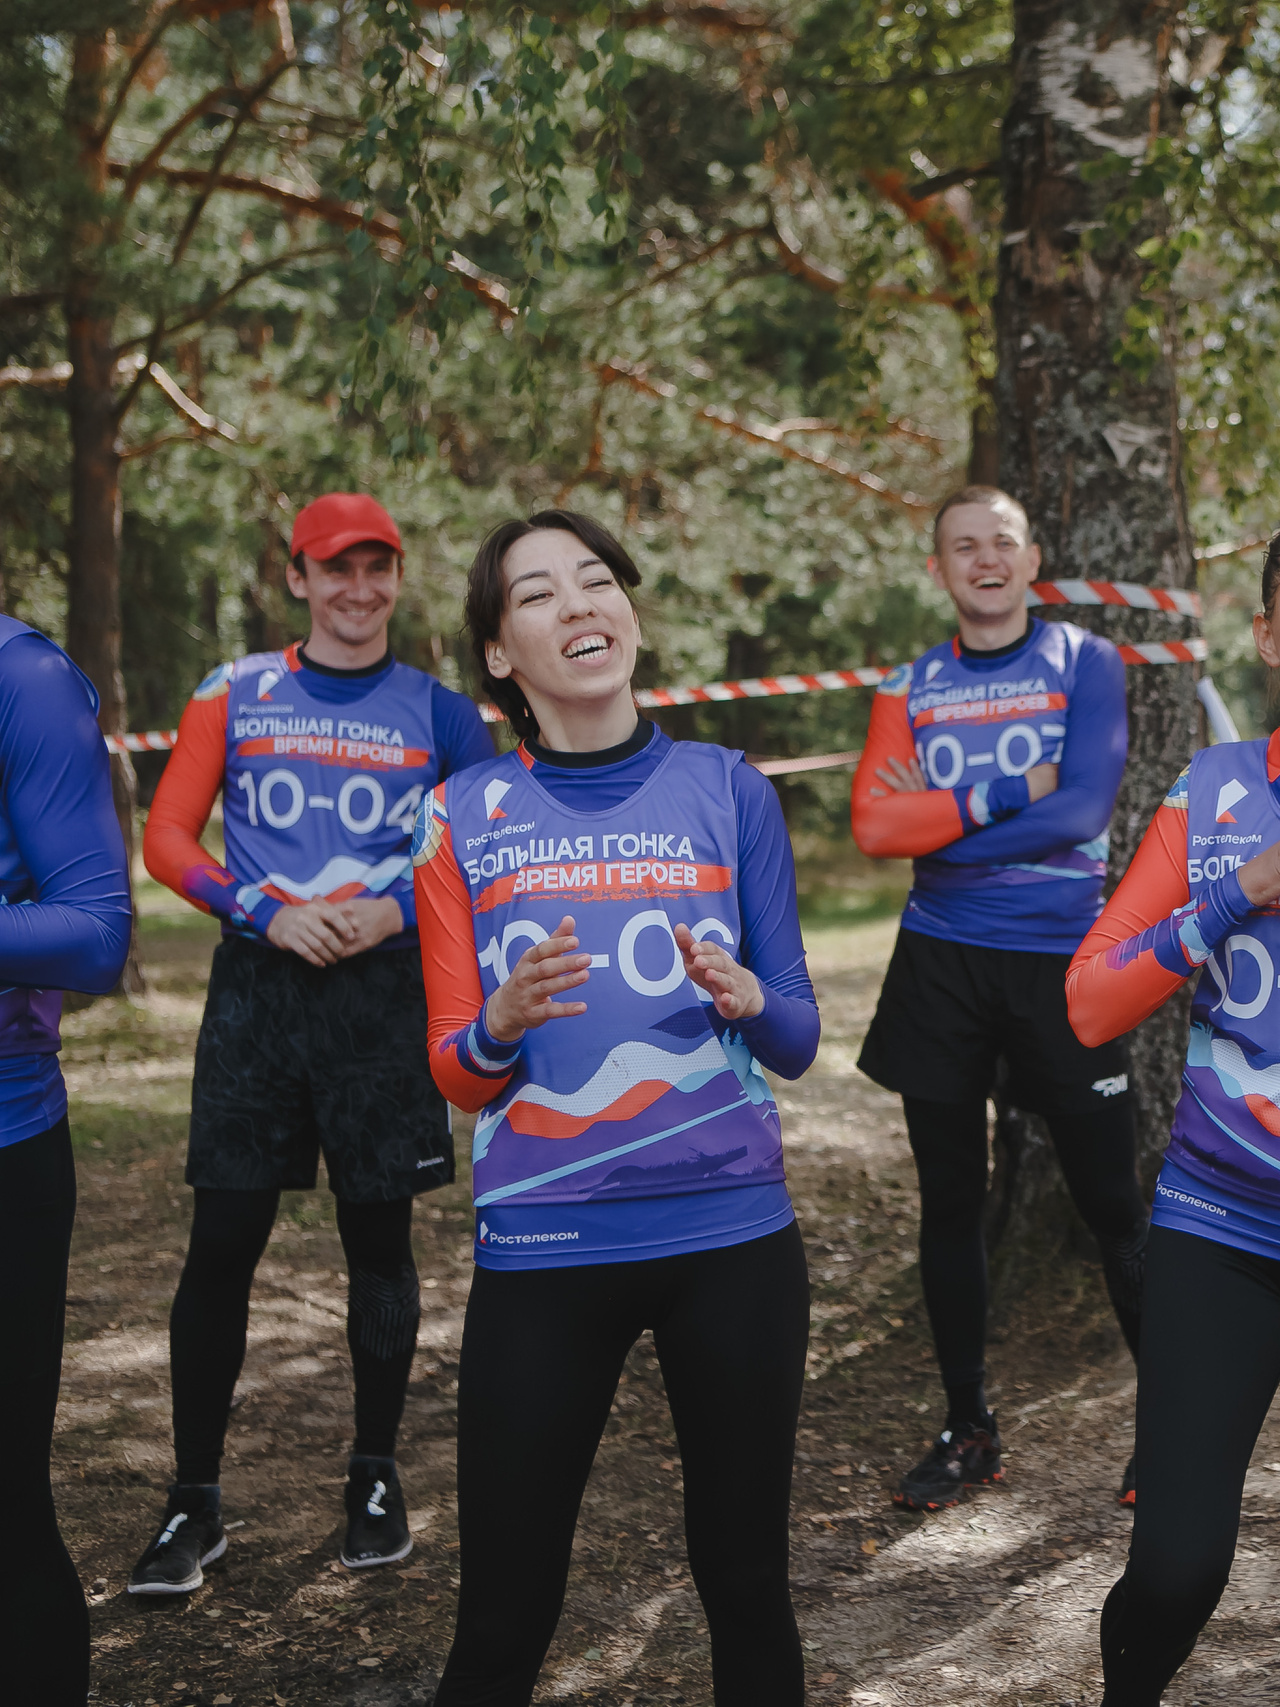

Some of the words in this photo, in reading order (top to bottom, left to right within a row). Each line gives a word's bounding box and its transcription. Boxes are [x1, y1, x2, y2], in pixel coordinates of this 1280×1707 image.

[988, 678, 1048, 700] ГОНКА
[933, 702, 987, 722] ВРЕМЯ
[988, 694, 1049, 715] ГЕРОЕВ
[234, 717, 333, 739] БОЛЬШАЯ
[337, 718, 404, 748] ГОНКА
[273, 737, 334, 756] ВРЕМЯ
[336, 739, 405, 766] ГЕРОЕВ
[238, 767, 424, 835] 10-04
[465, 820, 536, 850] Ростелеком
[1192, 834, 1262, 847] Ростелеком
[463, 835, 593, 885] БОЛЬШАЯ
[602, 831, 695, 861] ГОНКА
[512, 864, 598, 893] ВРЕМЯ
[604, 861, 698, 887] ГЕРОЕВ
[1155, 1183, 1227, 1217] Ростелеком
[489, 1230, 579, 1245] Ростелеком
